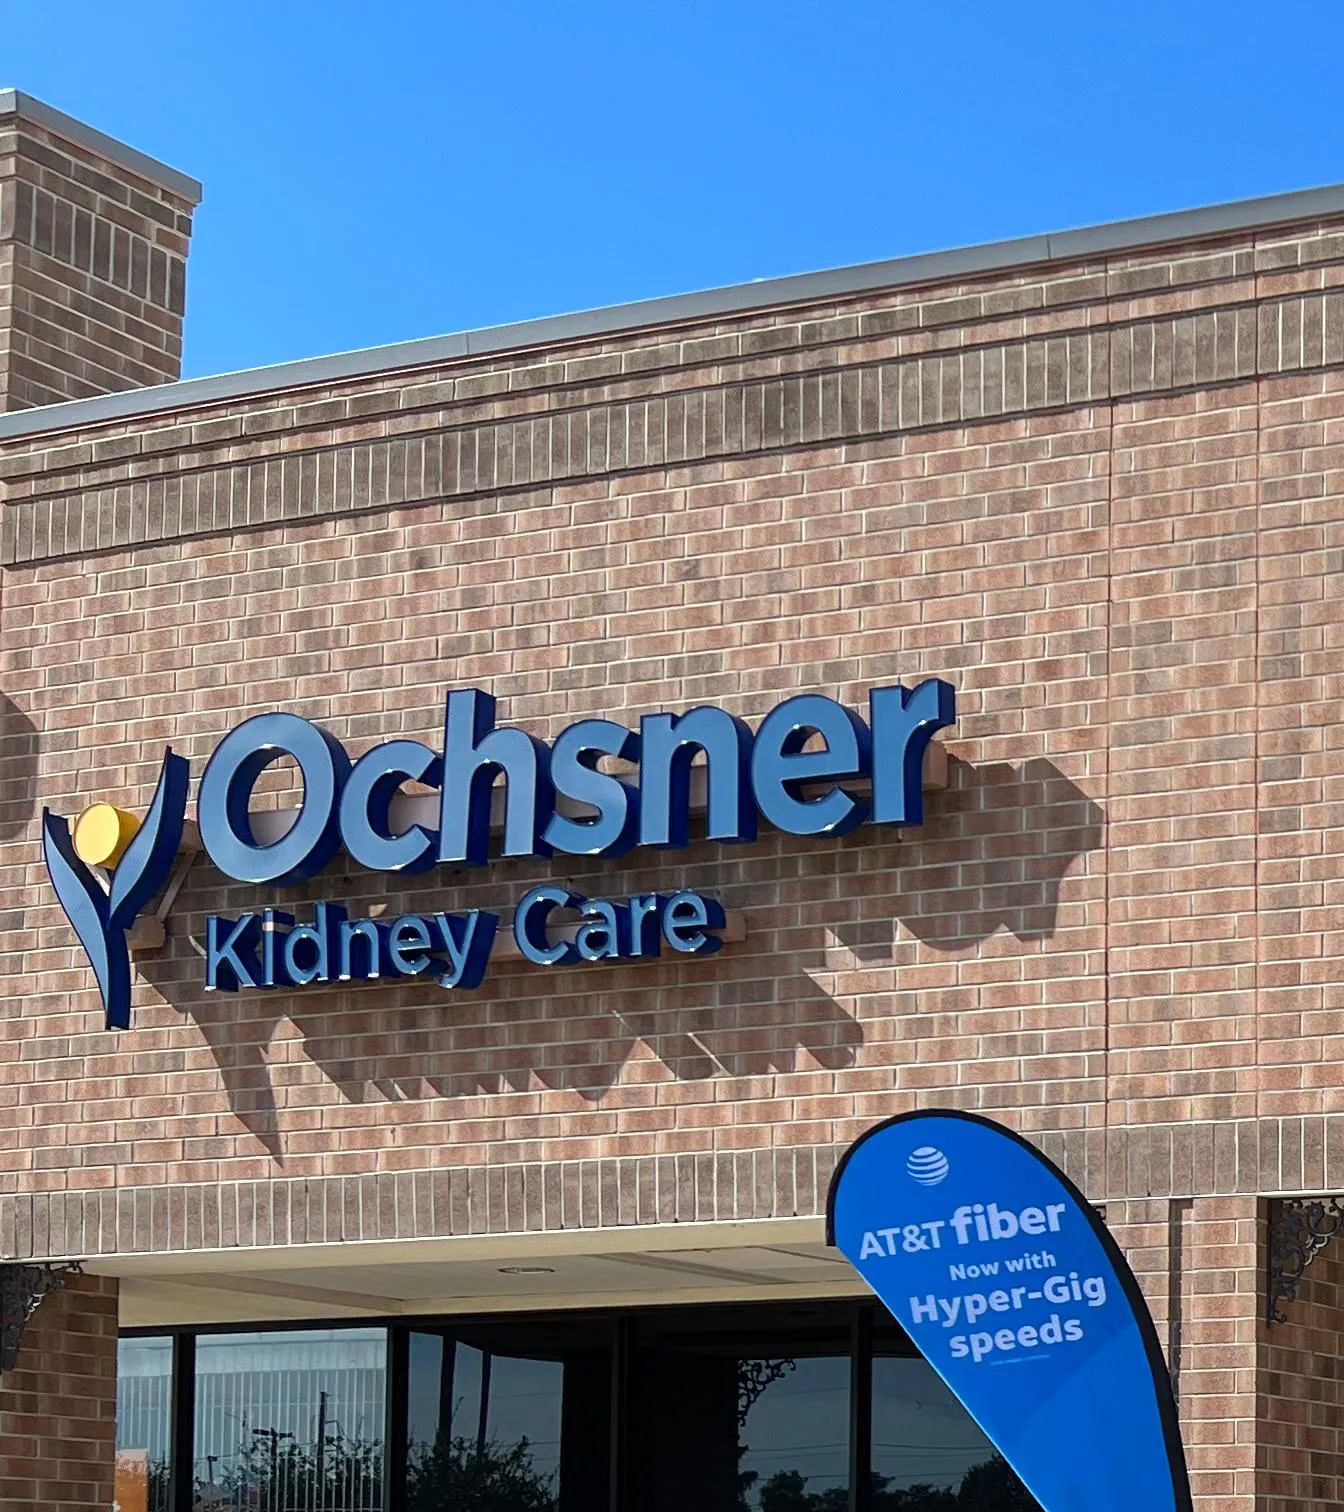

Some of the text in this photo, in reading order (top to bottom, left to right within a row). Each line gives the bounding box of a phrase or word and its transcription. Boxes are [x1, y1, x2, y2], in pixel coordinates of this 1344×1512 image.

[198, 678, 956, 885] Ochsner
[205, 885, 725, 991] Kidney Care
[859, 1202, 1066, 1261] AT&T fiber
[949, 1250, 1056, 1281] Now with
[909, 1272, 1107, 1328] Hyper-Gig
[950, 1314, 1084, 1363] speeds
